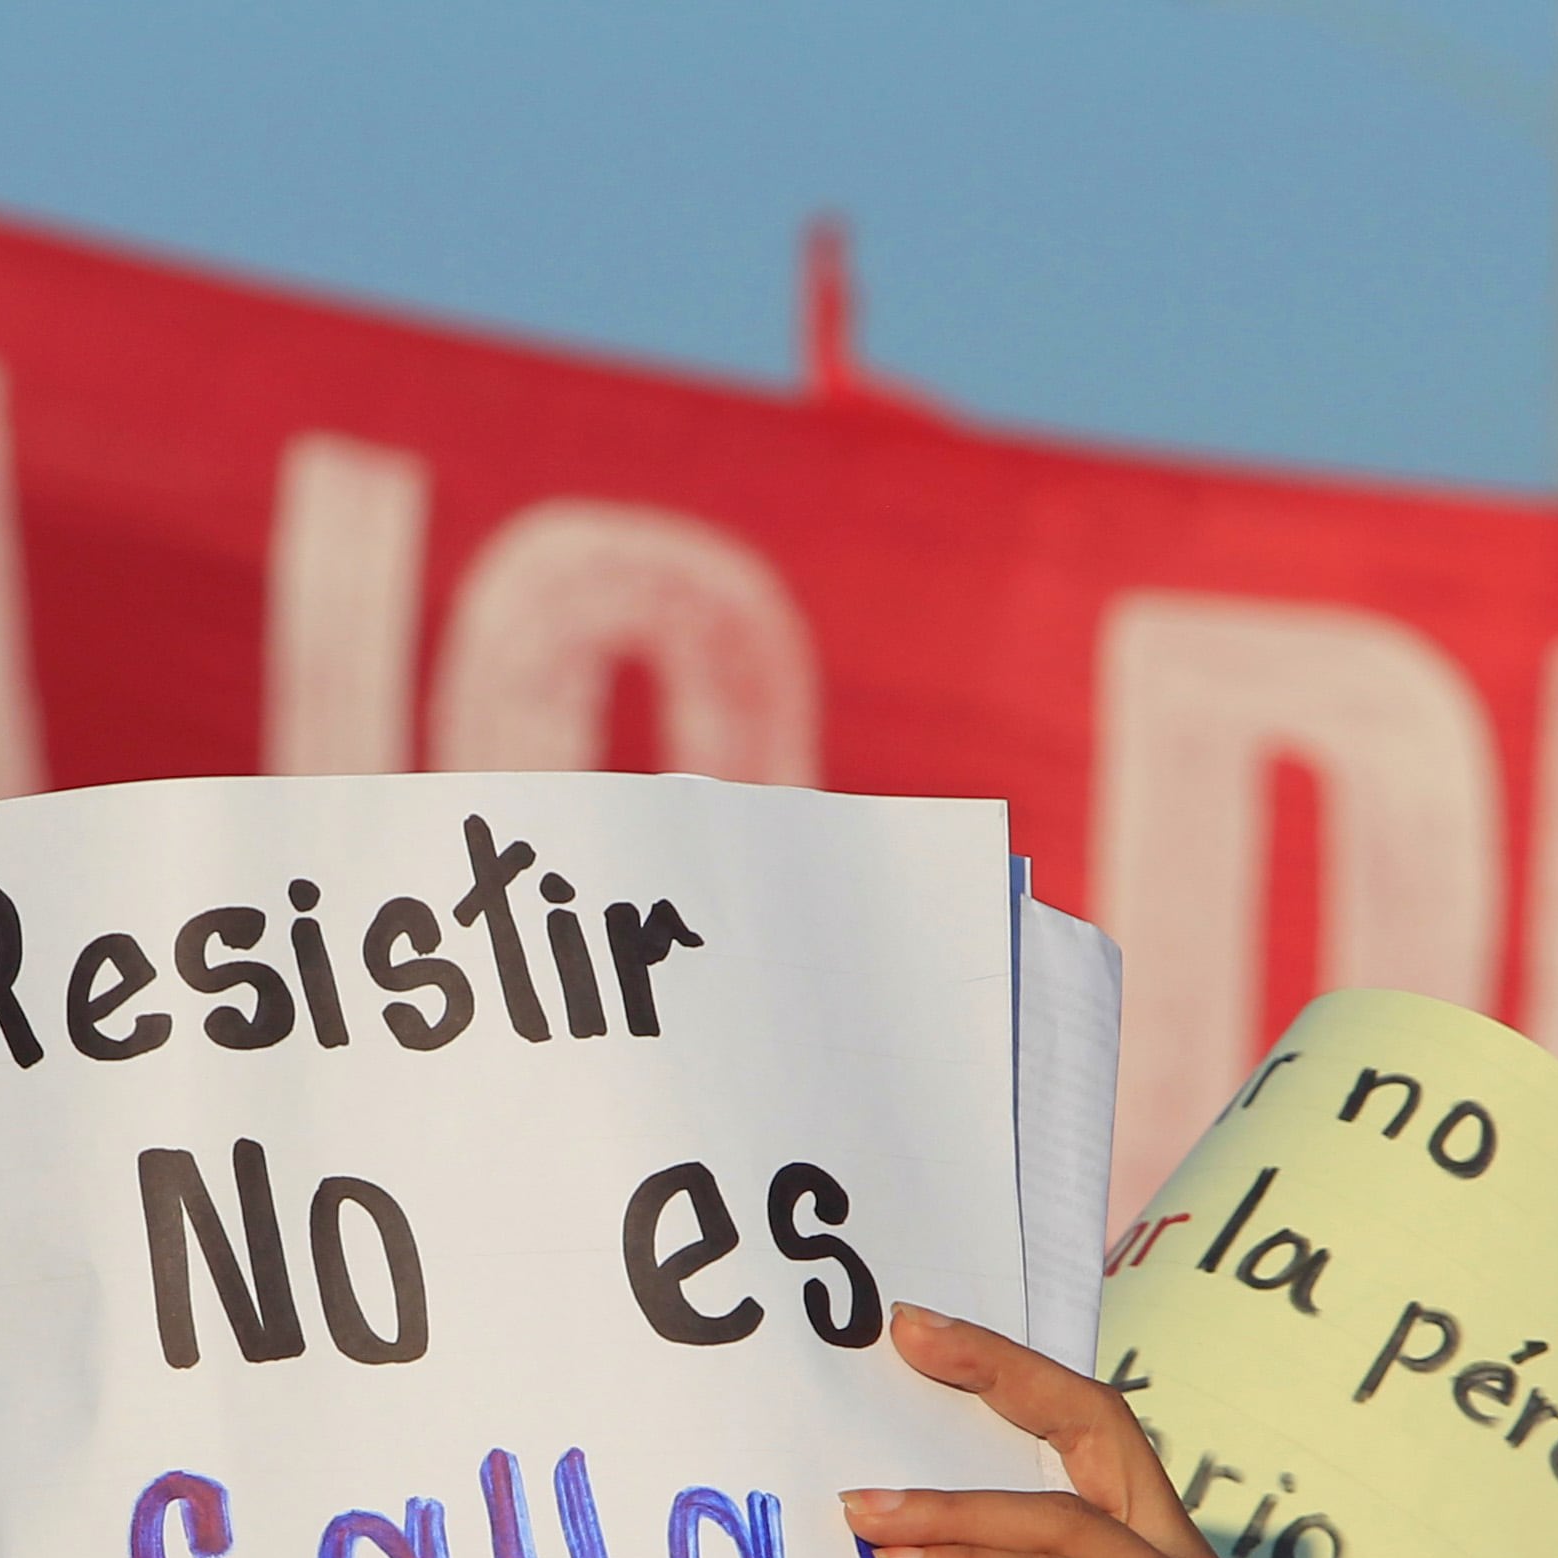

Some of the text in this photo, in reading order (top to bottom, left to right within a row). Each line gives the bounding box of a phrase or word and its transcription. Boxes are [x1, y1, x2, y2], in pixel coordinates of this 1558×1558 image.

[1336, 1066, 1498, 1180] no
[621, 1160, 885, 1349] es
[1194, 1166, 1332, 1316] la
